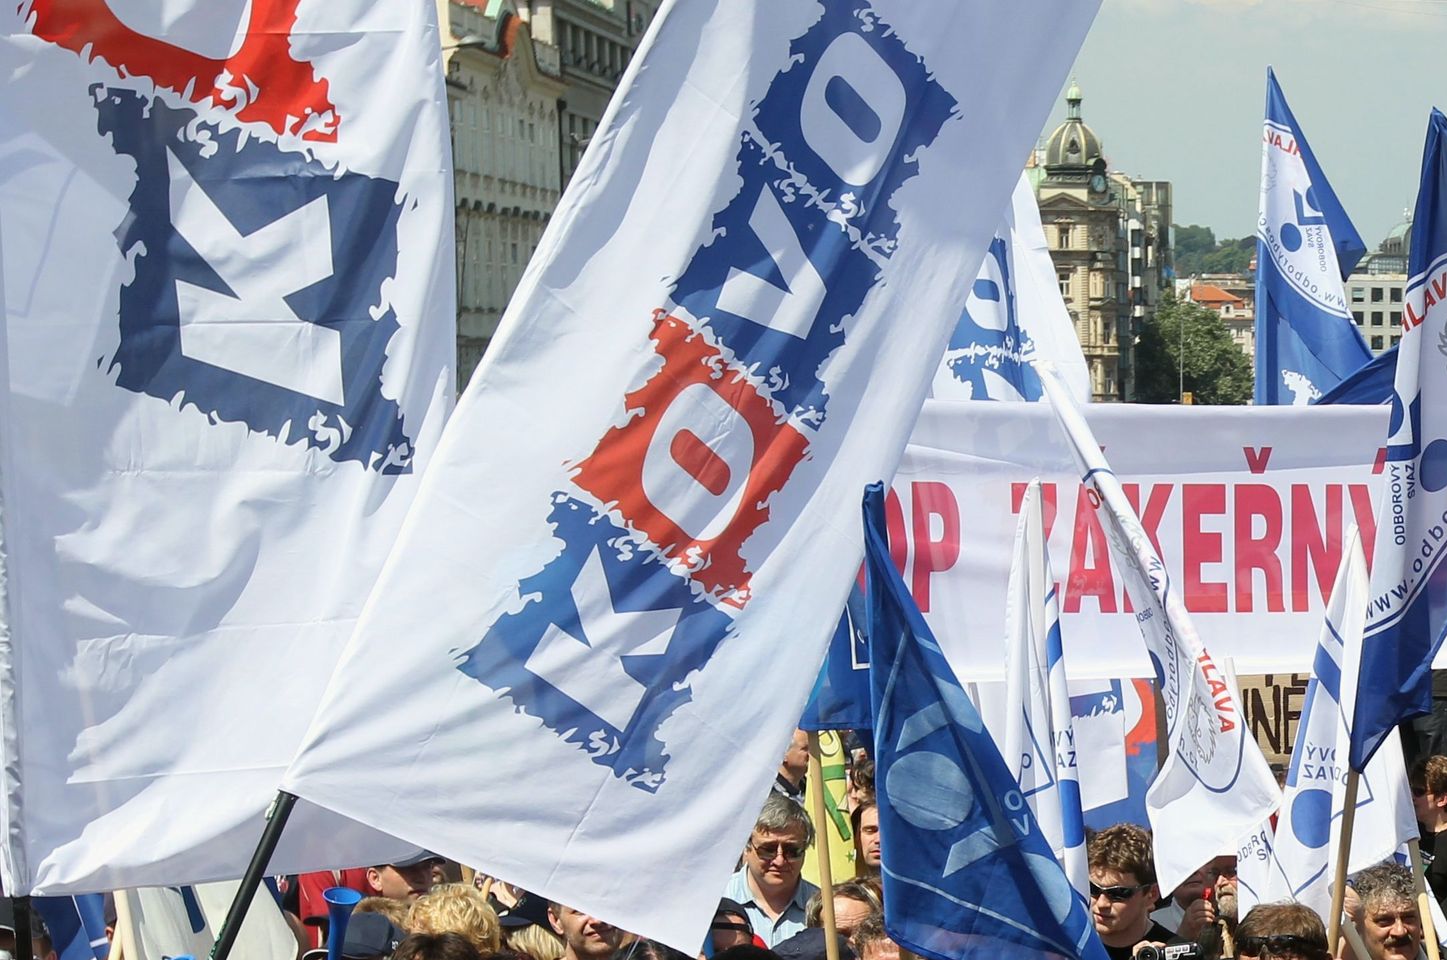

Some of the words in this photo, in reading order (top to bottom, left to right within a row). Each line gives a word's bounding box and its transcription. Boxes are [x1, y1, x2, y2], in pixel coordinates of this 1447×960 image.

[523, 29, 907, 734] KOVO
[1389, 463, 1407, 547] ODBOROVÝ
[1407, 462, 1417, 501] SVAZ
